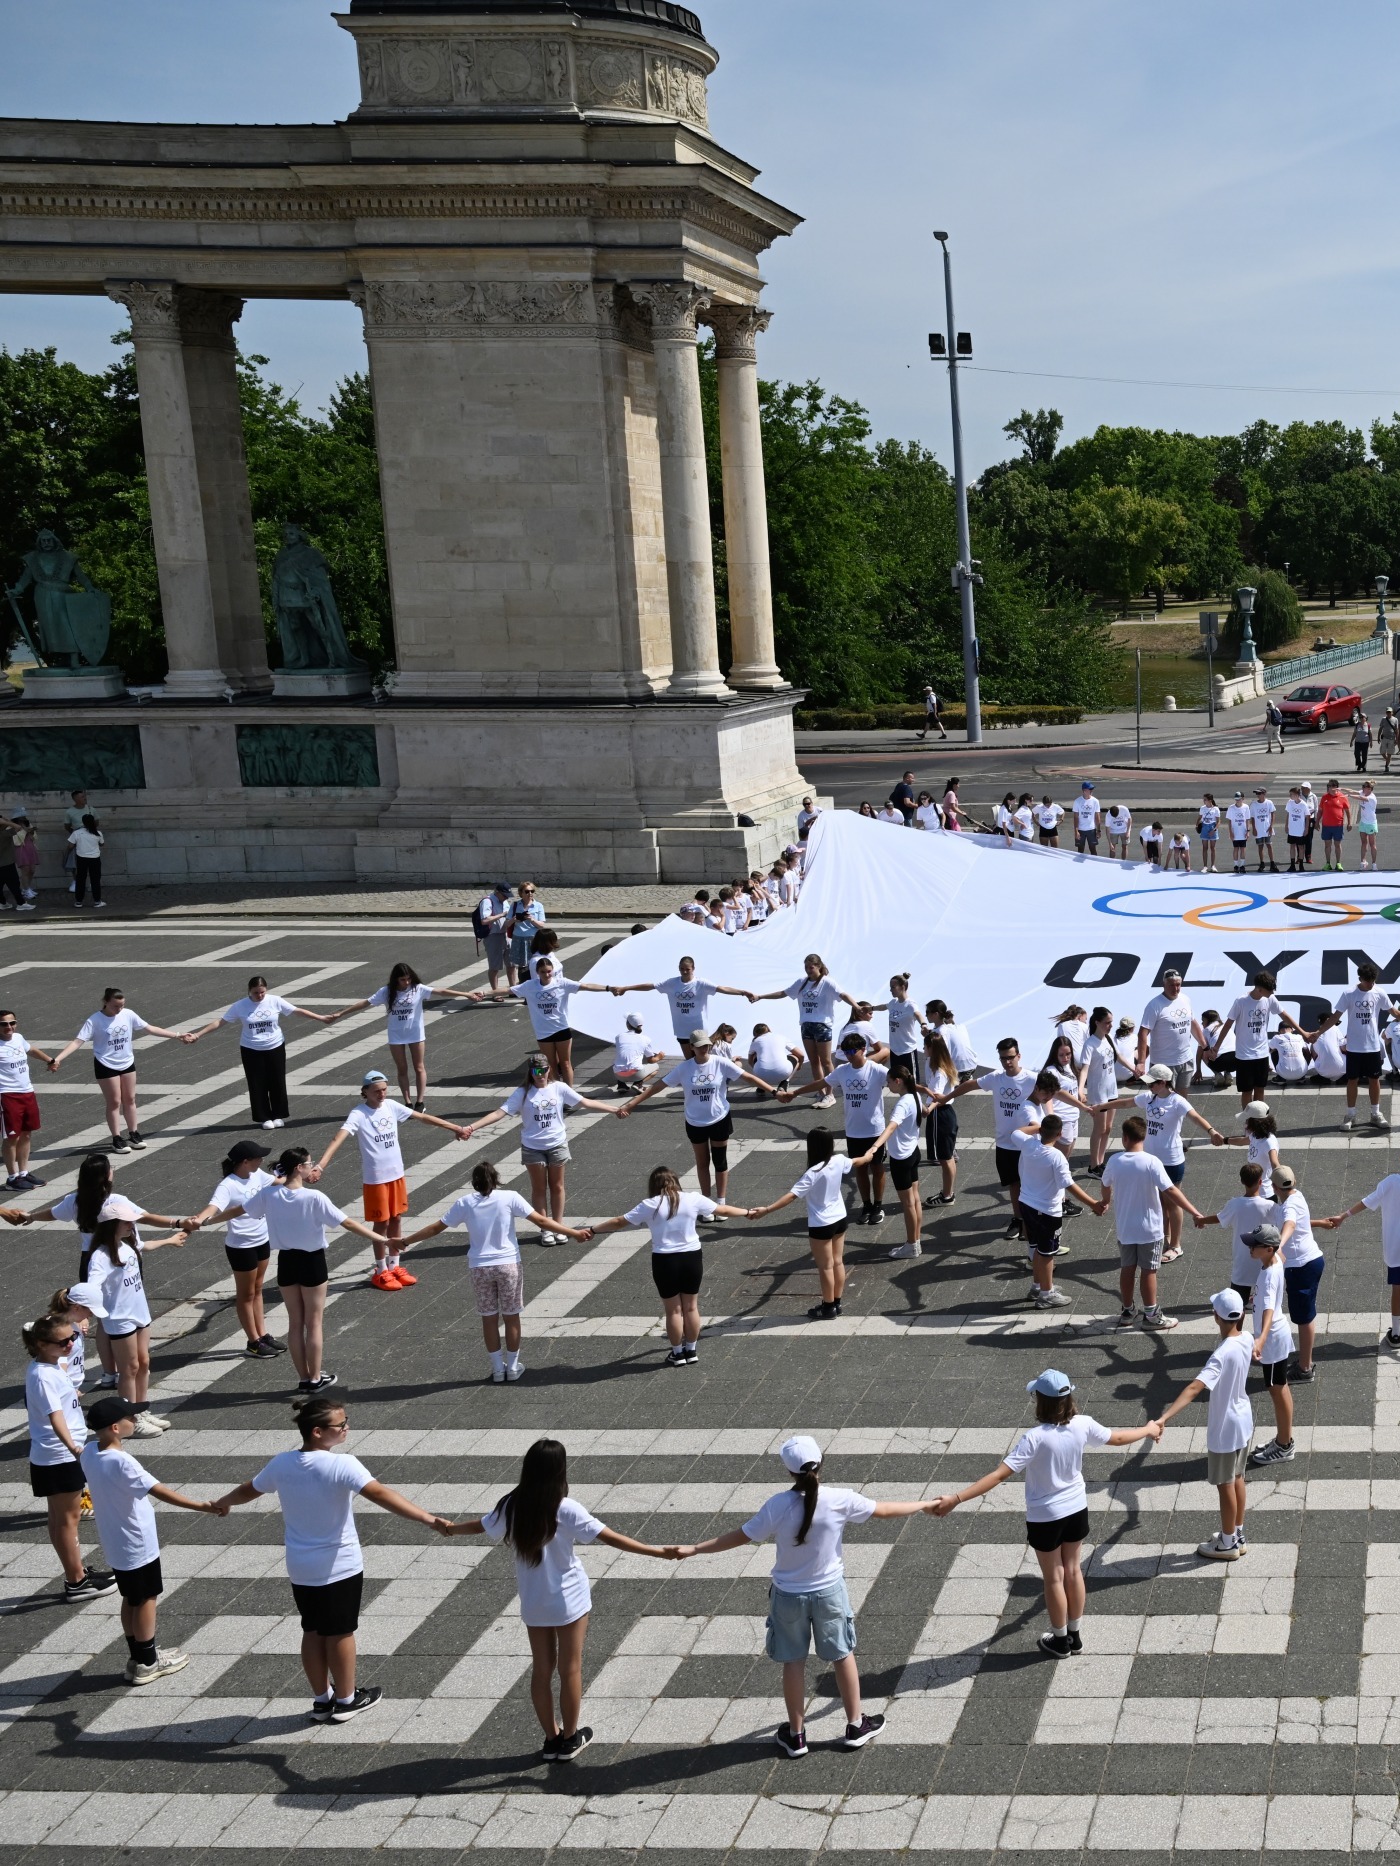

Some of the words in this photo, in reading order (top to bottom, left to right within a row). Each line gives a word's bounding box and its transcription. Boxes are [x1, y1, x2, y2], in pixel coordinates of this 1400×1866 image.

[537, 1002, 557, 1010] OLYMPIC
[249, 1021, 272, 1029] OLYMPIC
[1172, 1020, 1190, 1030] OLYMPIC
[108, 1037, 129, 1046] OLYMPIC
[11, 1059, 27, 1069] OLYMP
[692, 1088, 715, 1096] OLYMPIC
[846, 1093, 868, 1101] OLYMPIC
[1000, 1101, 1021, 1110] OLYMPIC
[534, 1113, 557, 1121] OLYMPIC
[541, 1121, 552, 1129] DAY
[1148, 1128, 1158, 1136] DAY
[384, 1141, 395, 1149] DAY
[123, 1273, 142, 1287] OLYM
